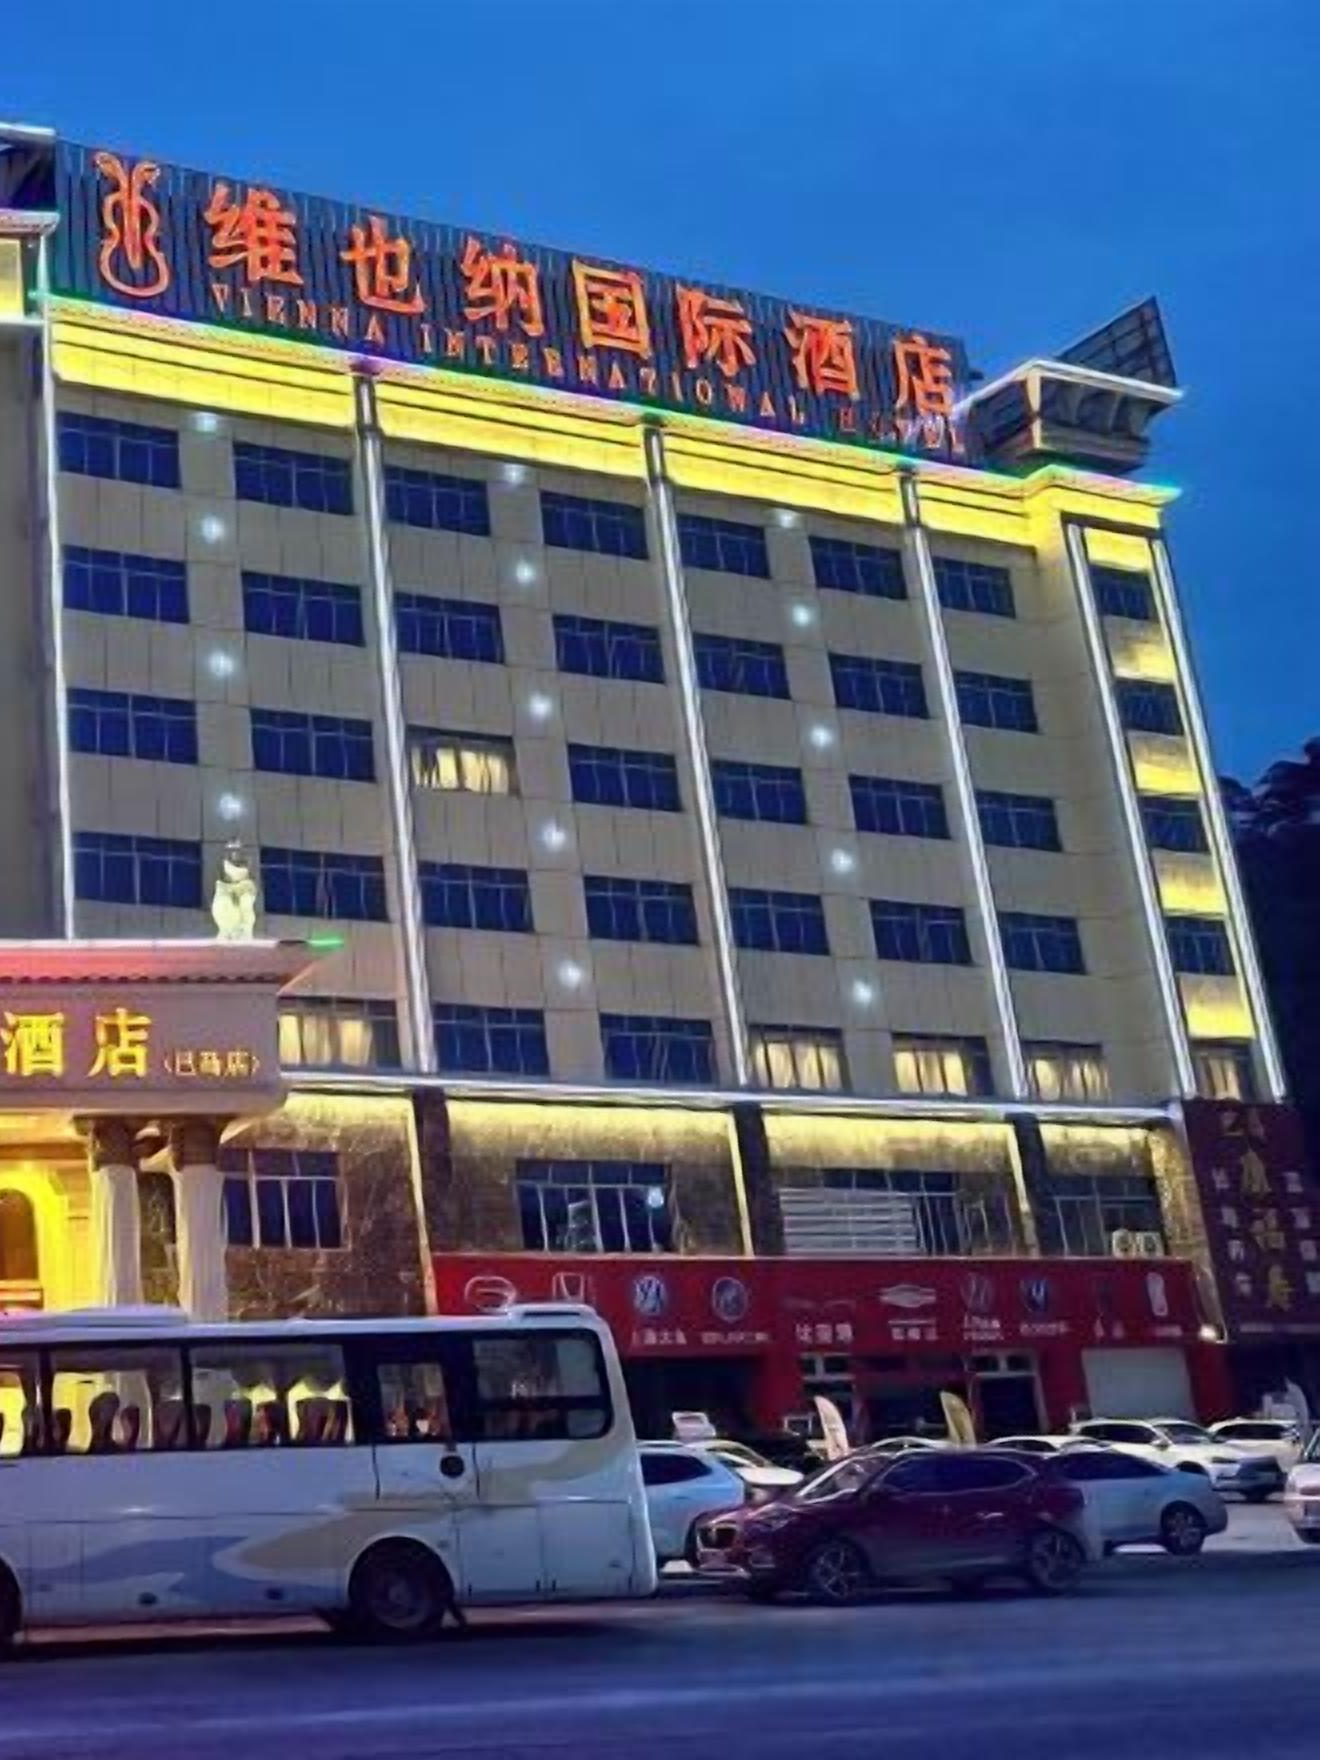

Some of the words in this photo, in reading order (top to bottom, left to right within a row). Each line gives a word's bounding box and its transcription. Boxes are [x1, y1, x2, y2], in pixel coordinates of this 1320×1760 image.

[202, 182, 955, 418] 维也纳国际酒店
[211, 282, 385, 345] VIENNA
[420, 322, 806, 425] INTERNATIONAL
